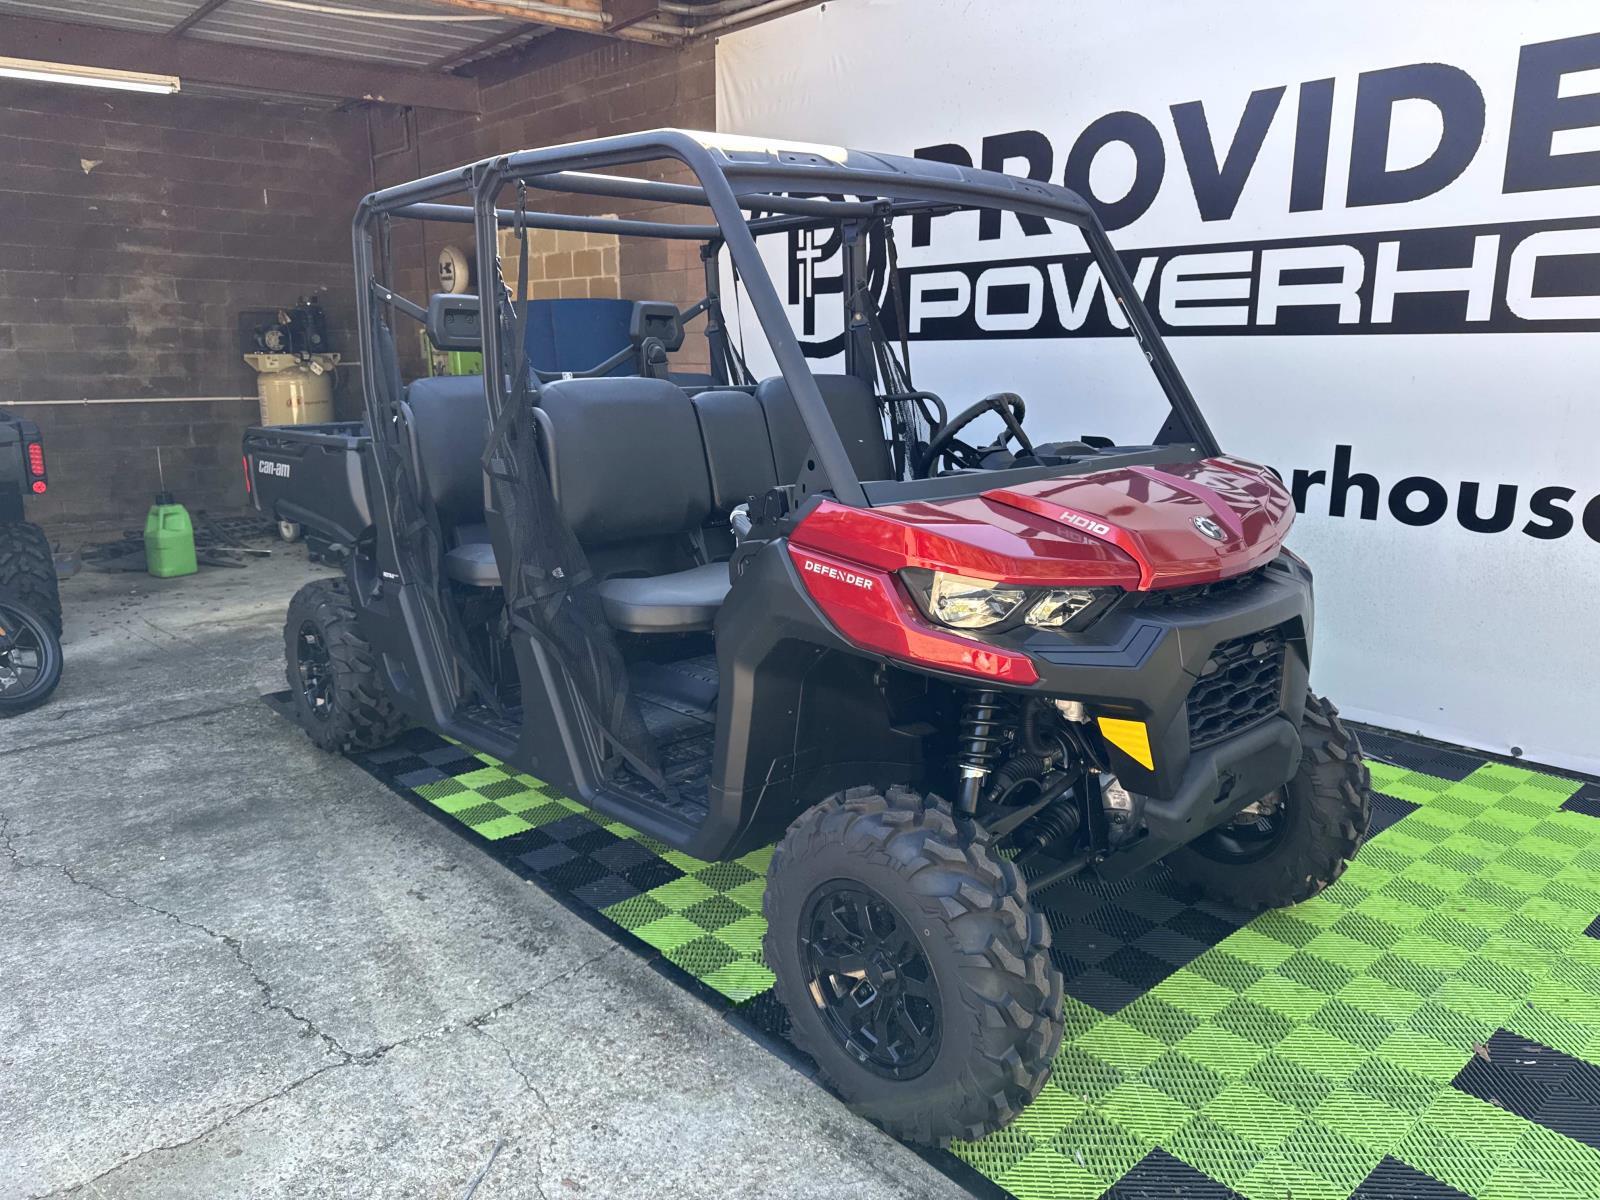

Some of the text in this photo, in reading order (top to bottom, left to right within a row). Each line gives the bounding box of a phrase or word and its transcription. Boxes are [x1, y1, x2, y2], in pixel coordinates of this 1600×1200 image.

[258, 460, 290, 478] can-am
[1060, 511, 1110, 535] HD10
[804, 560, 873, 590] DEFENDER
